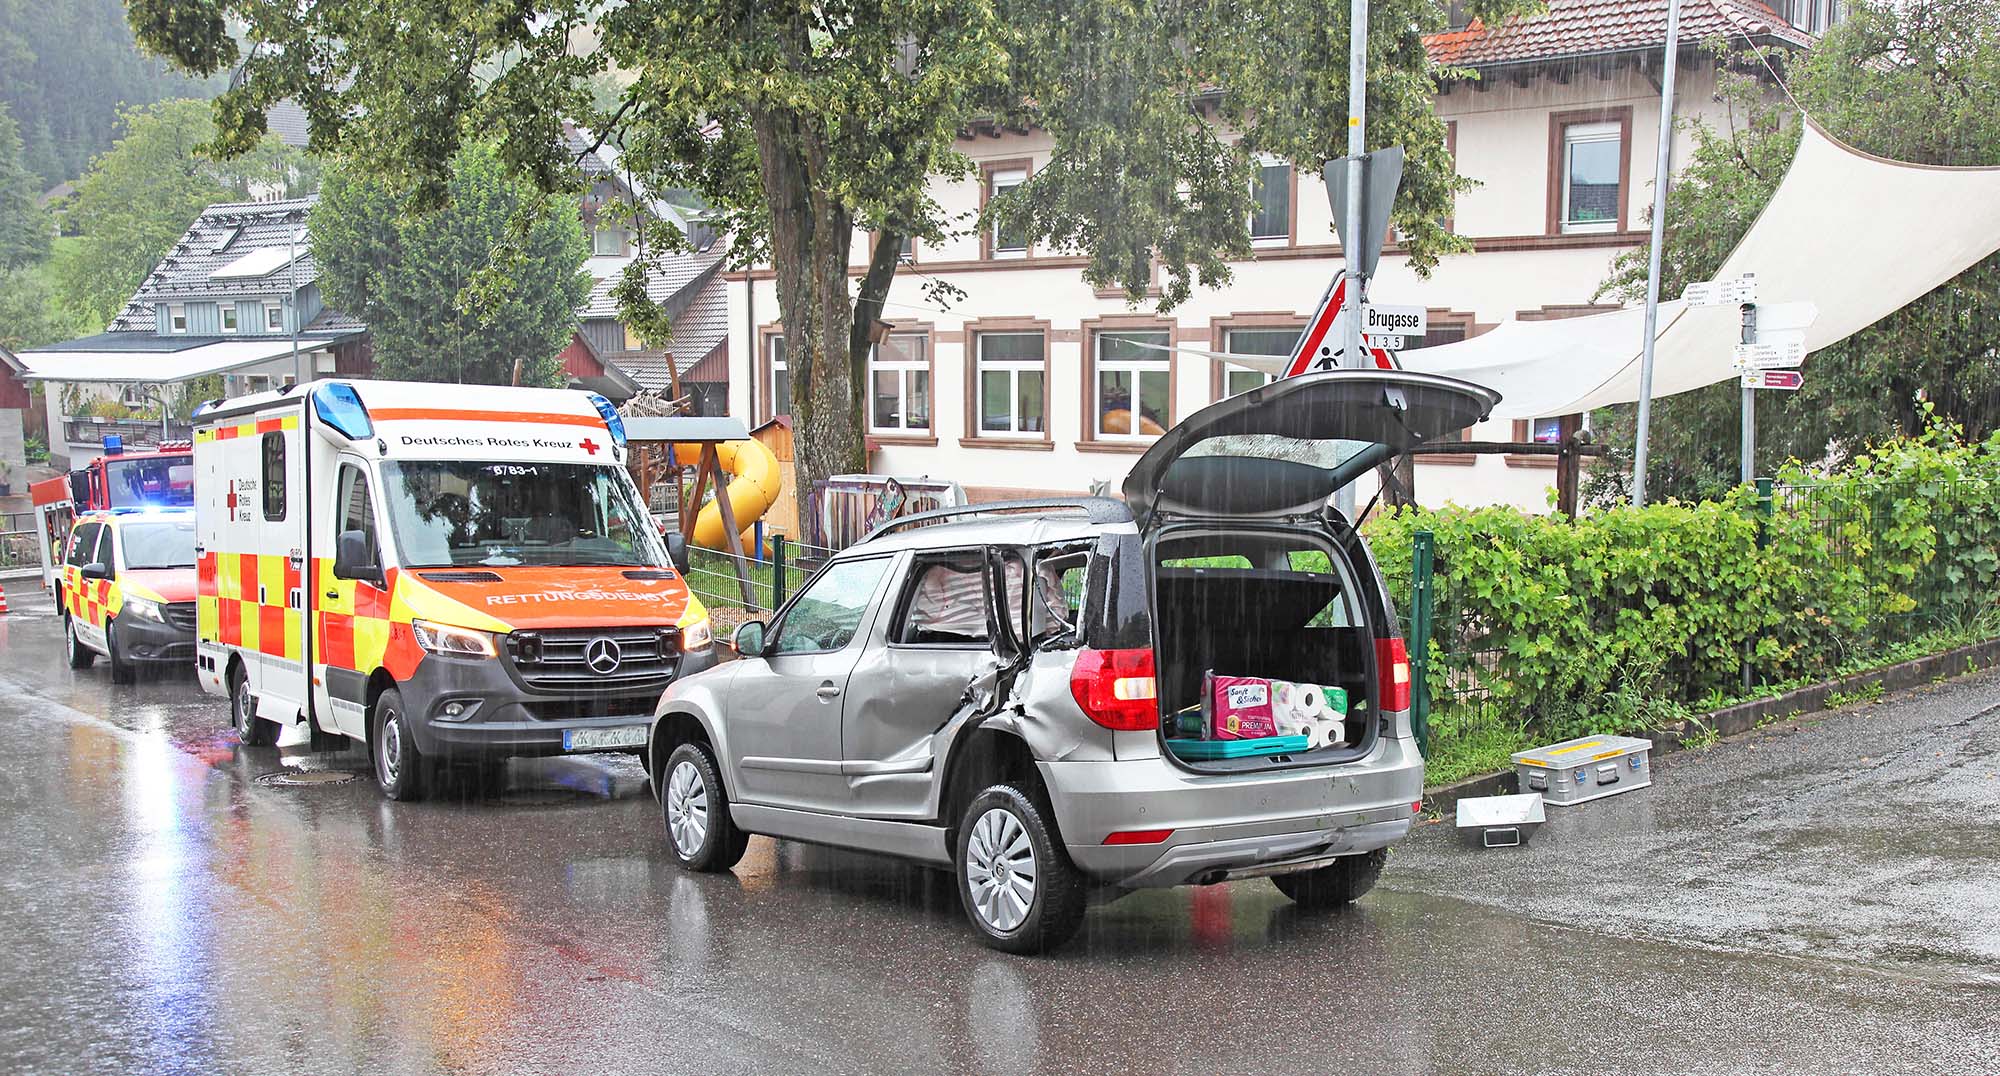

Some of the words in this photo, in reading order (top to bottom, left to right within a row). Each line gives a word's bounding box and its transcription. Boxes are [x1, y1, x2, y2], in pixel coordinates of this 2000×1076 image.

[1368, 308, 1419, 331] Brugasse
[1394, 336, 1400, 347] 5
[401, 435, 483, 447] Deutsches
[487, 437, 530, 448] Rotes
[533, 438, 573, 449] Kreuz
[486, 589, 672, 605] RETTUNGSDIENST
[1230, 687, 1249, 696] Sanft
